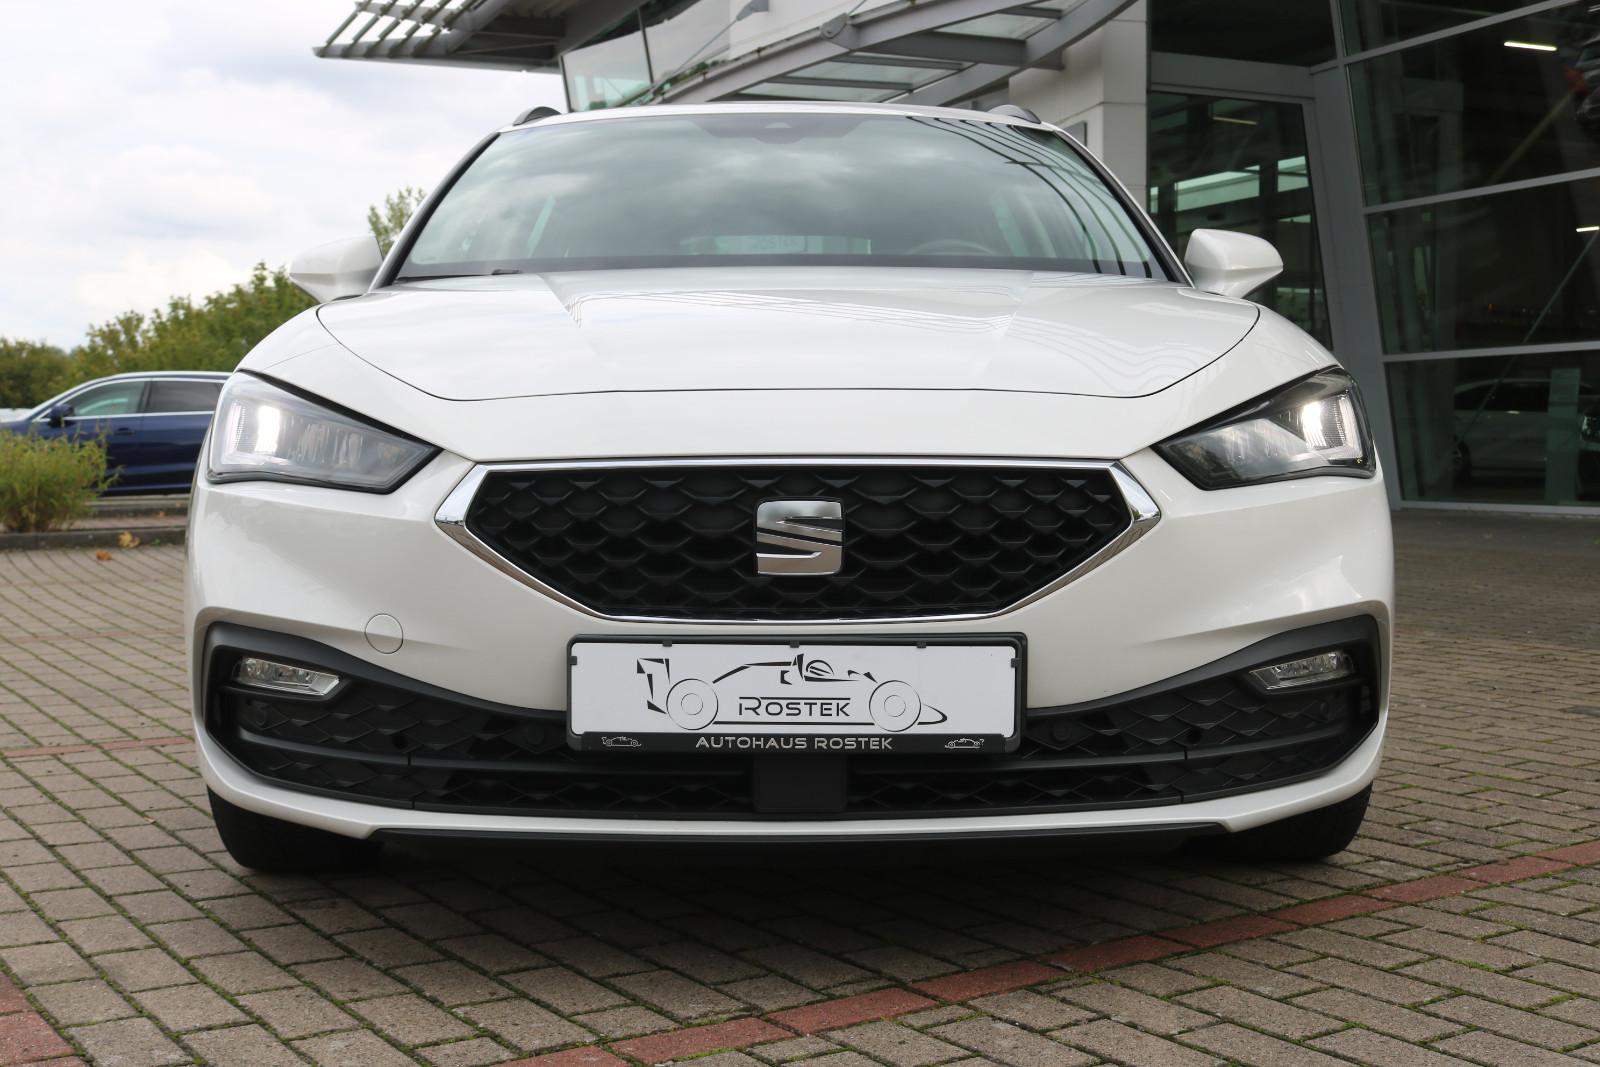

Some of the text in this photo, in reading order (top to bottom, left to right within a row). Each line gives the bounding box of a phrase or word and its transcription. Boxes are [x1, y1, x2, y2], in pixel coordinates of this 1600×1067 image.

[739, 697, 850, 717] ROSTEK
[696, 737, 892, 749] AUTOHAUS ROSTEK
